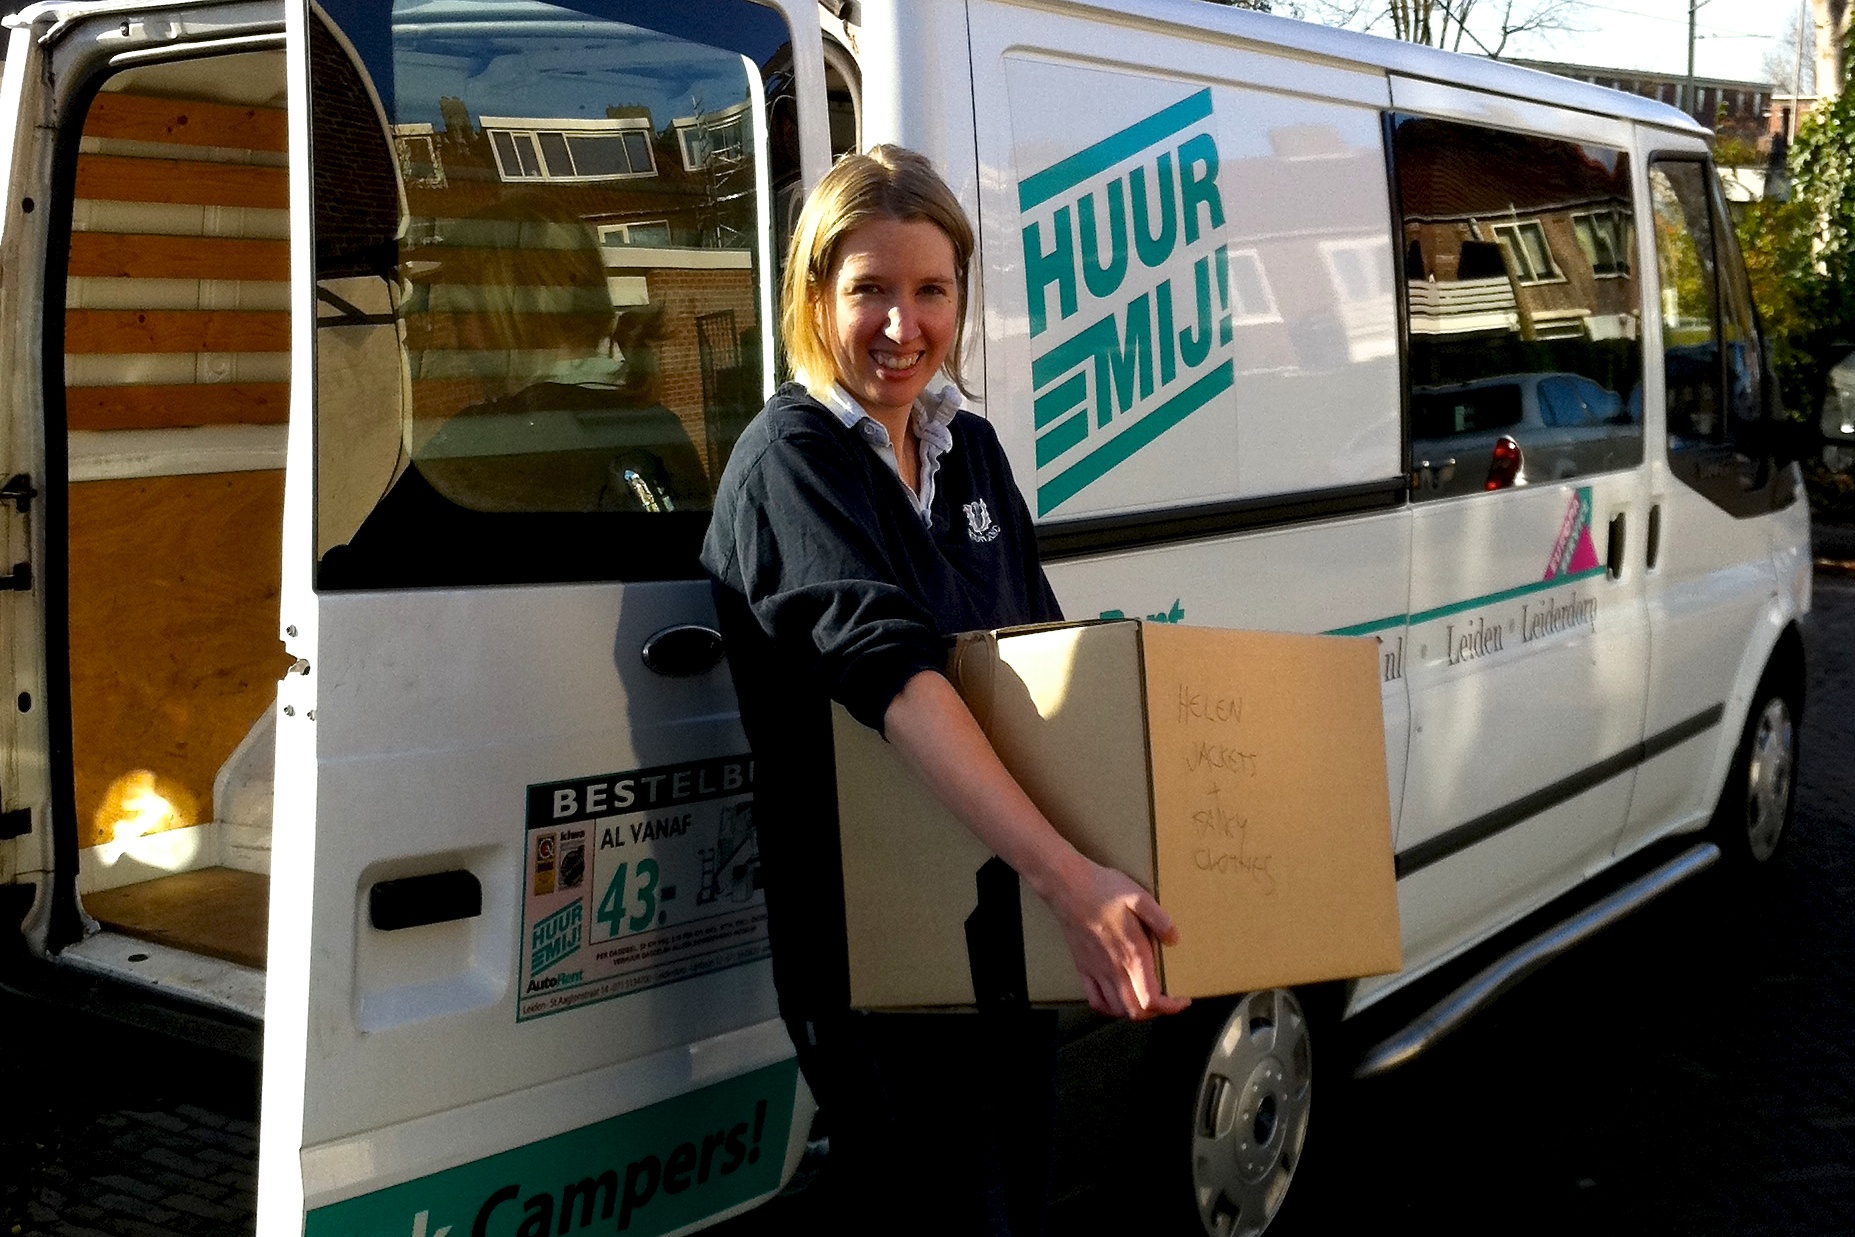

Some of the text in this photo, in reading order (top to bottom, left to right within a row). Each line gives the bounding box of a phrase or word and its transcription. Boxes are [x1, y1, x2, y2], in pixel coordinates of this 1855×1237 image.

[1022, 133, 1226, 339] HUUR
[1091, 243, 1233, 430] MIJ!
[1447, 617, 1504, 667] Leiden
[1521, 592, 1598, 644] Leiderdorp
[1178, 684, 1242, 725] HELEN
[552, 760, 755, 820] BESTELB
[600, 813, 693, 851] AL VANAF
[533, 902, 583, 950] HUUR
[526, 969, 584, 994] AutoRent
[472, 1100, 768, 1237] Campers!
